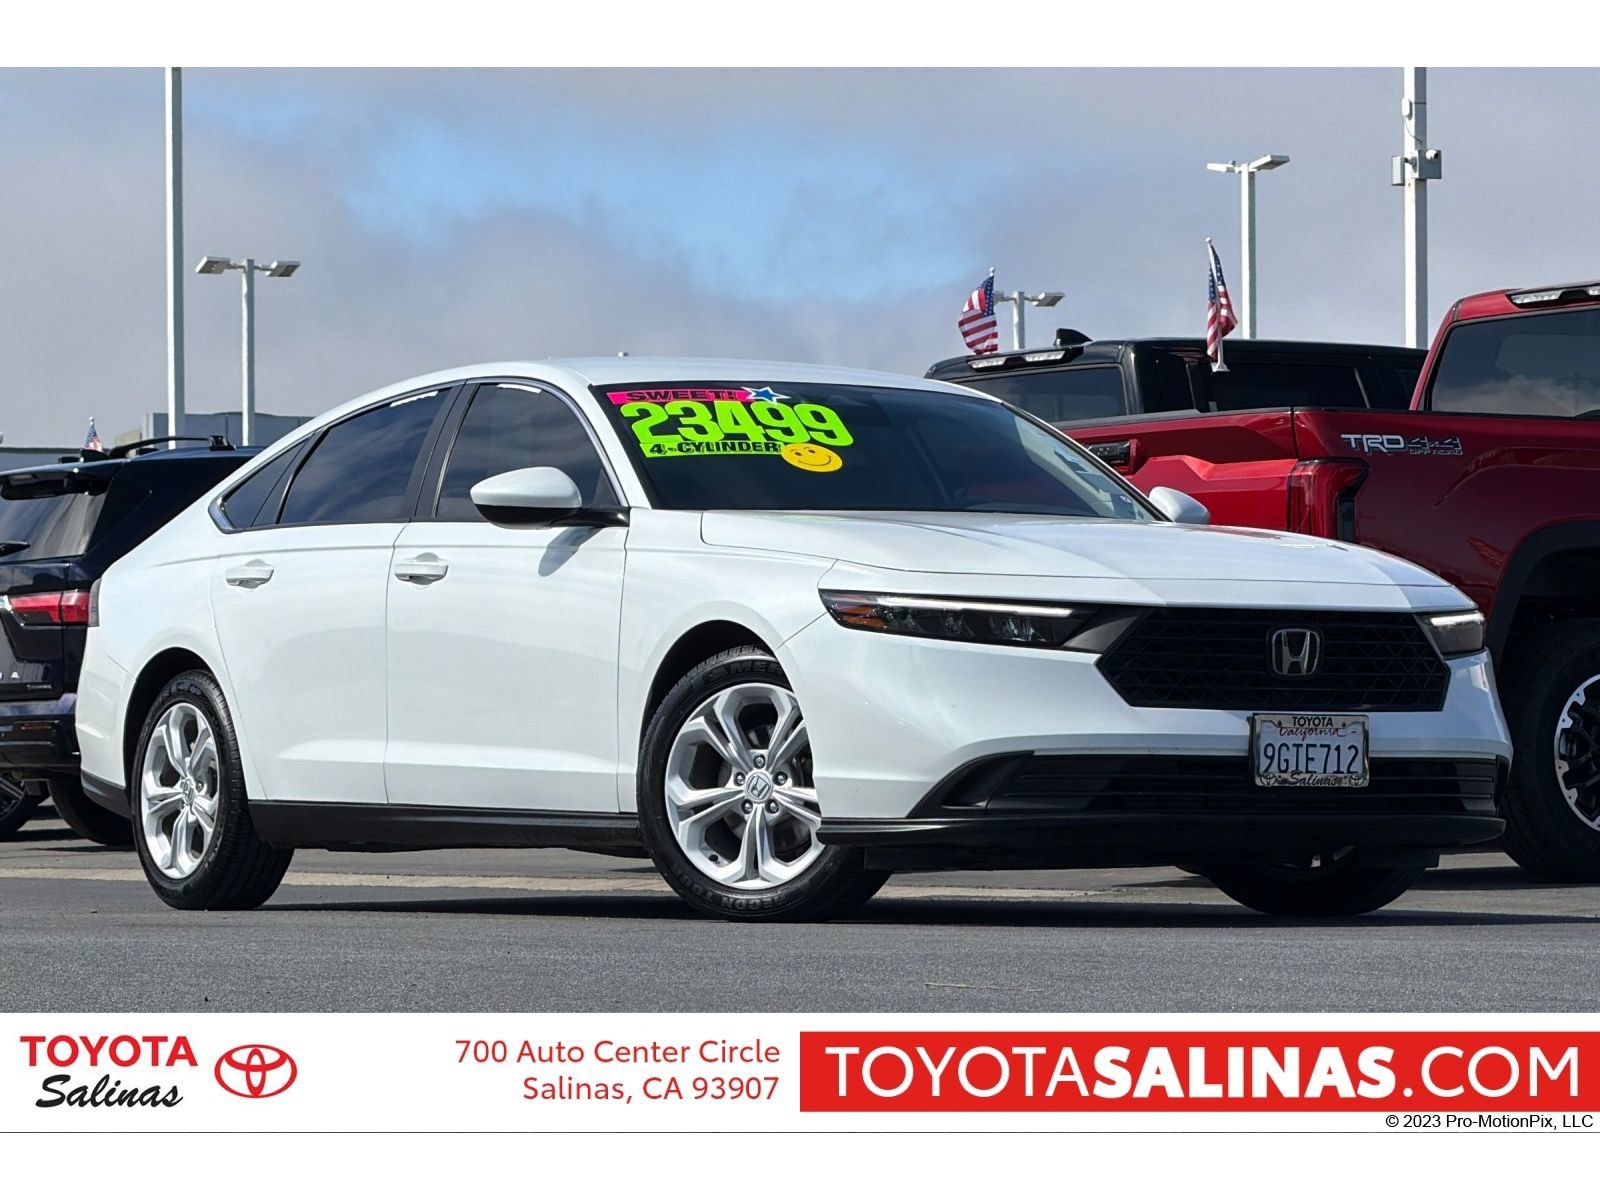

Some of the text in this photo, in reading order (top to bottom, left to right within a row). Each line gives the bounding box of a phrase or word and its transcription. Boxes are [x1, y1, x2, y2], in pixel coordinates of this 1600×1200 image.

[626, 390, 735, 402] SWEET!
[619, 400, 854, 447] 23499
[649, 440, 782, 455] 4-CYLINDER
[1341, 434, 1405, 453] TRD
[1291, 716, 1334, 728] TOYOTA
[1280, 727, 1346, 742] California
[1263, 742, 1359, 774] 9GIE712
[1290, 770, 1336, 786] Salinas
